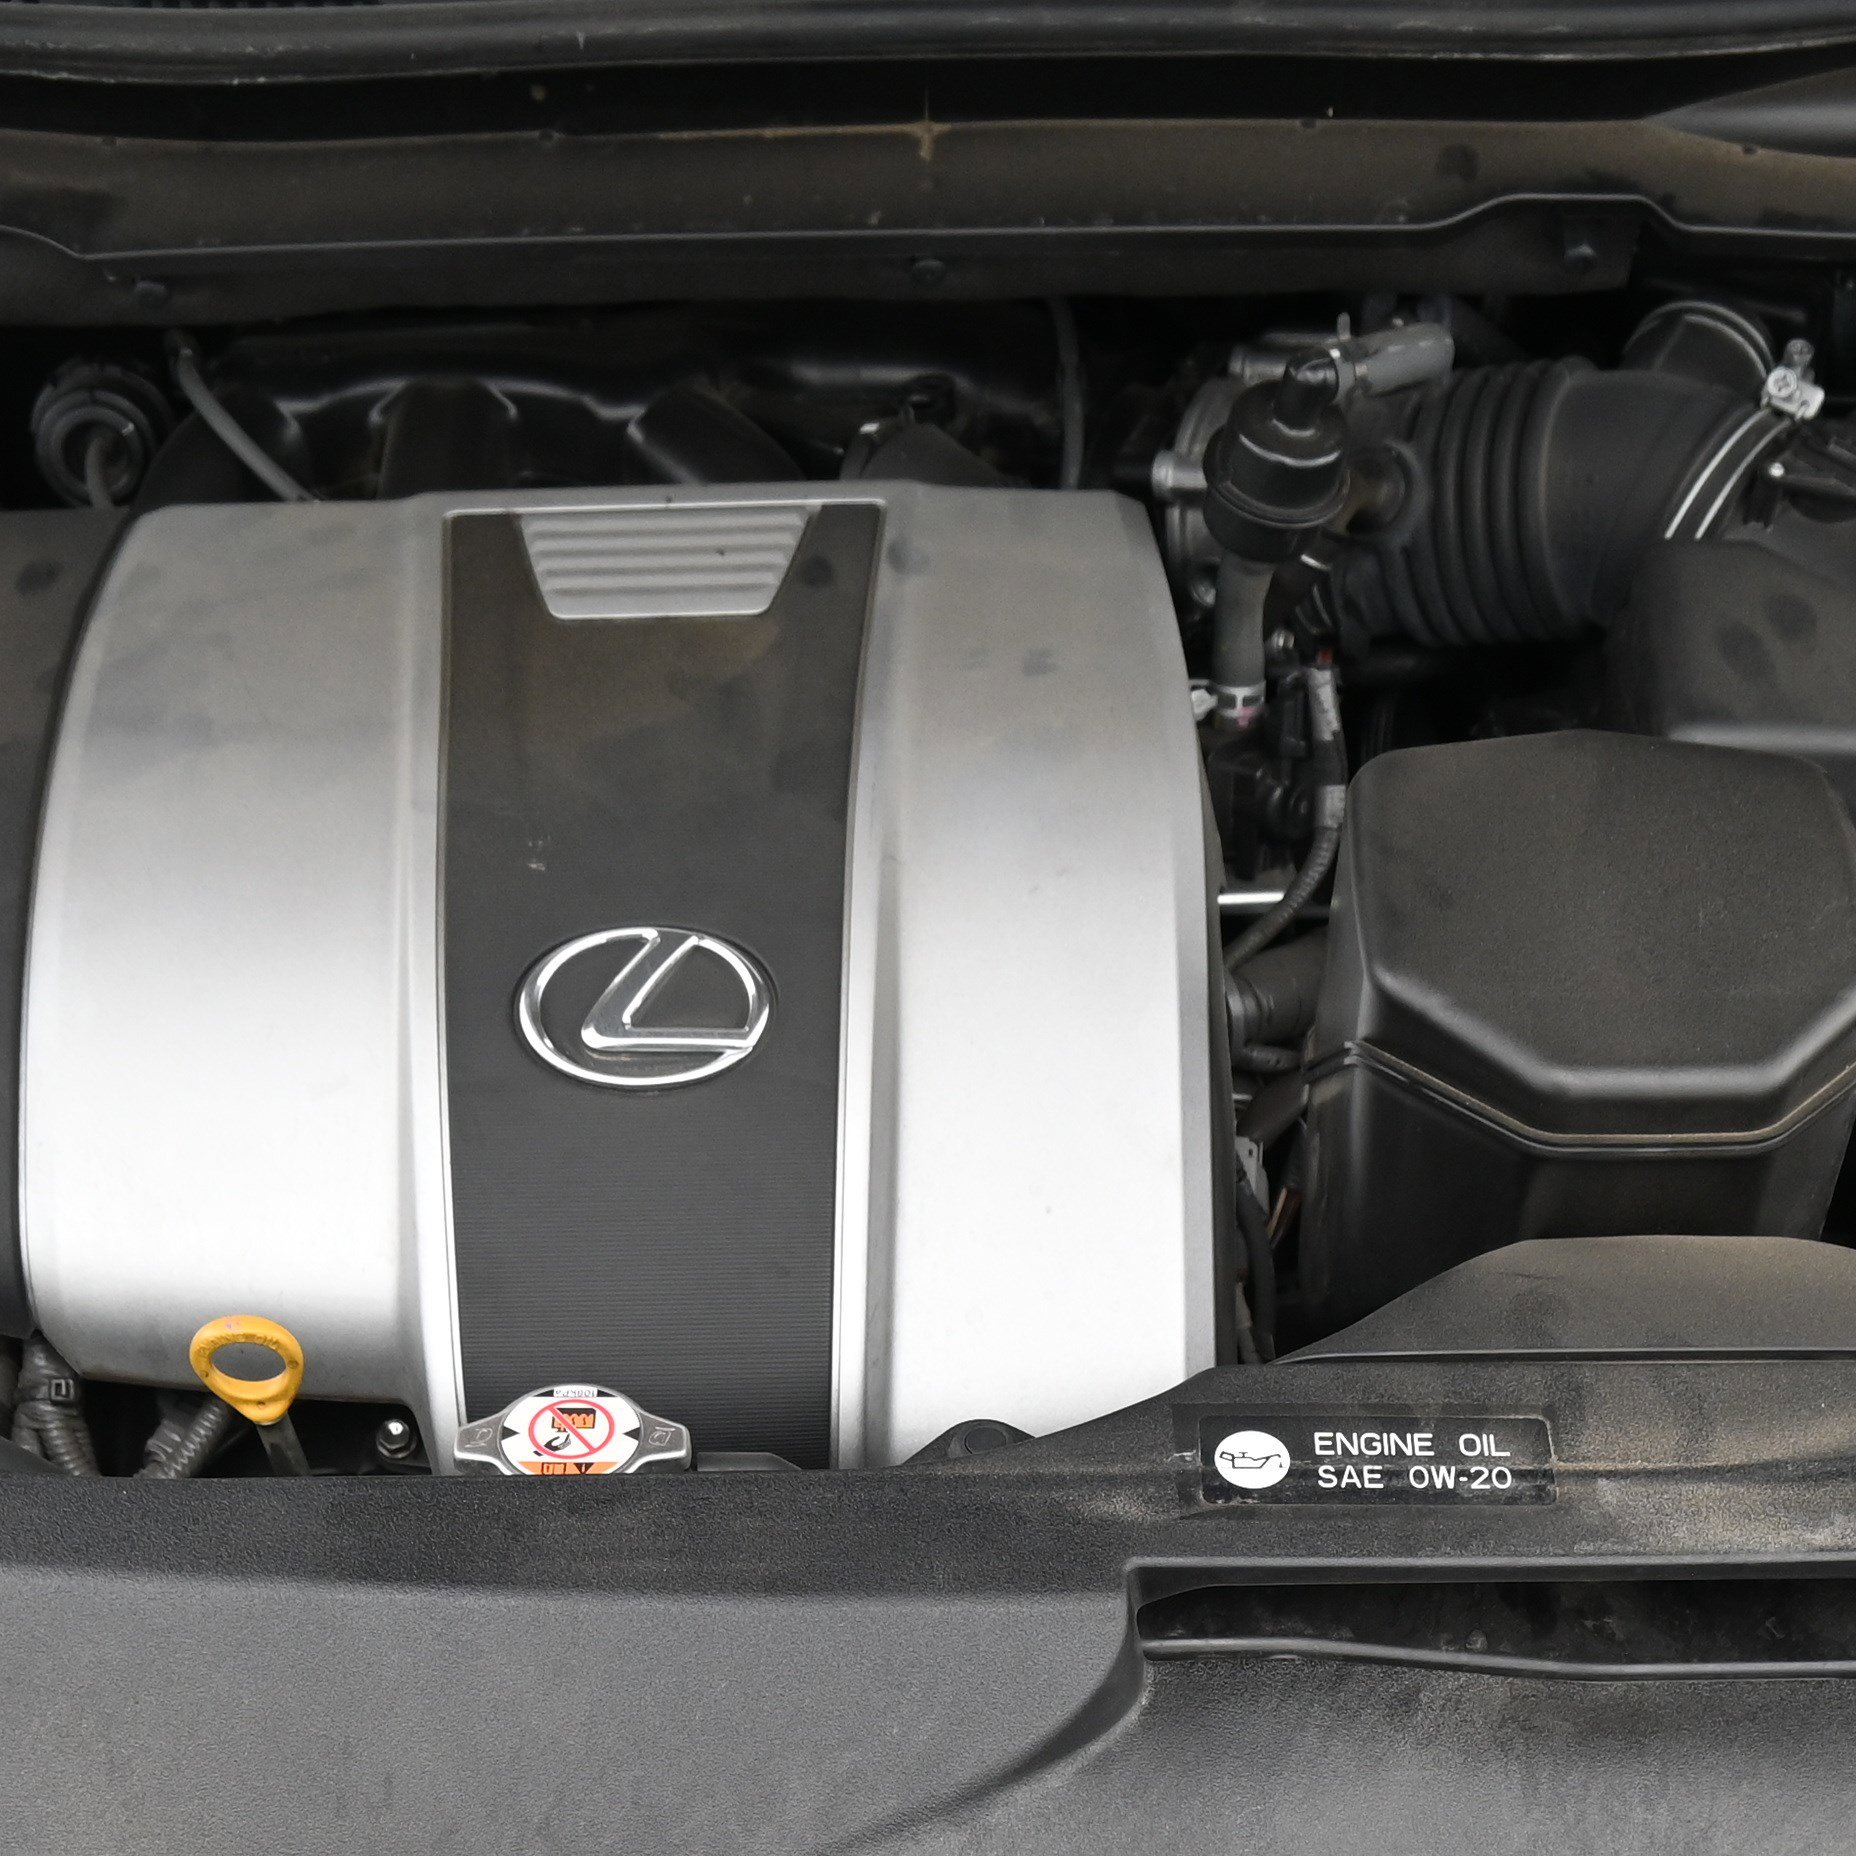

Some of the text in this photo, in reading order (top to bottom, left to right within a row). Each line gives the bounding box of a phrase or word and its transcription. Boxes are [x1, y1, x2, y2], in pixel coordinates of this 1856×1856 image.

[1313, 1431, 1511, 1458] ENGINE OIL
[1317, 1465, 1513, 1490] SAE 0W-20
